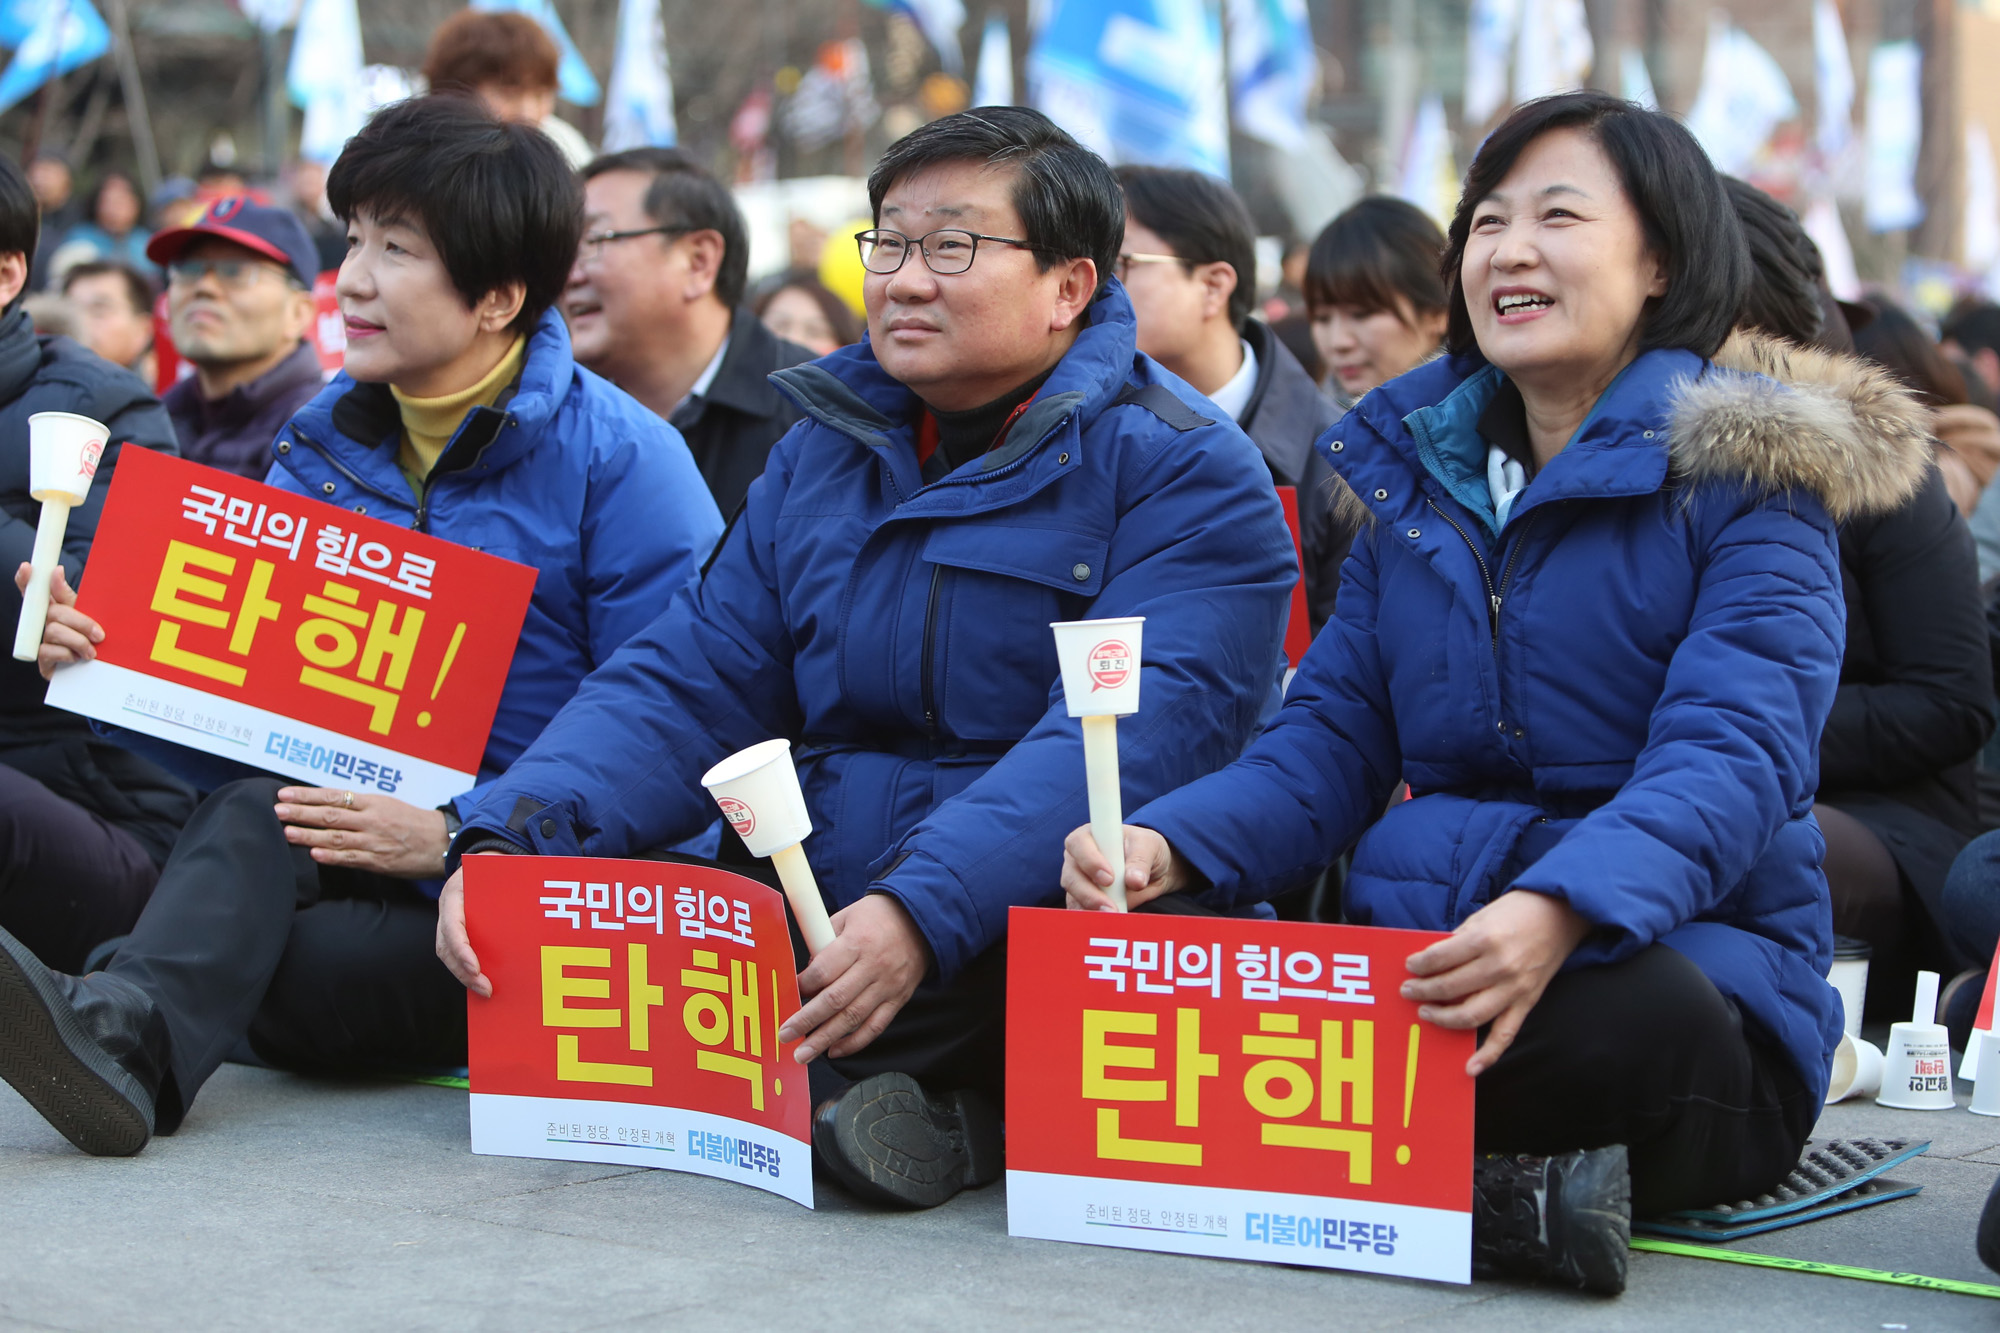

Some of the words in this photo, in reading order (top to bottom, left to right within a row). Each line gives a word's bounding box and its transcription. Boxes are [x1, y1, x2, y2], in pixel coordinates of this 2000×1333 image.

[182, 485, 308, 561] 국민의
[315, 525, 436, 599] 힘으로
[150, 539, 466, 736] 탄핵!
[124, 693, 160, 712] 준비된
[193, 713, 228, 733] 안정된
[230, 725, 253, 742] 개혁
[265, 732, 402, 793] 더불어민주당
[540, 881, 663, 934] 국민의
[674, 887, 755, 947] 힘으로
[1084, 938, 1221, 998] 국민의
[1235, 944, 1375, 1004] 힘으로
[541, 943, 782, 1111] 탄핵!
[1909, 1076, 1948, 1091] 황교안
[1915, 1060, 1944, 1075] 탄핵!
[1082, 1008, 1420, 1185] 탄핵!
[546, 1122, 582, 1138] 준비된
[617, 1127, 651, 1144] 안정된
[655, 1130, 676, 1146] 개혁
[688, 1130, 780, 1178] 더불어민주당
[1085, 1203, 1122, 1222] 준비된
[1161, 1210, 1198, 1229] 안정된
[1203, 1214, 1229, 1232] 개혁
[1246, 1213, 1398, 1256] 더불어민주당
